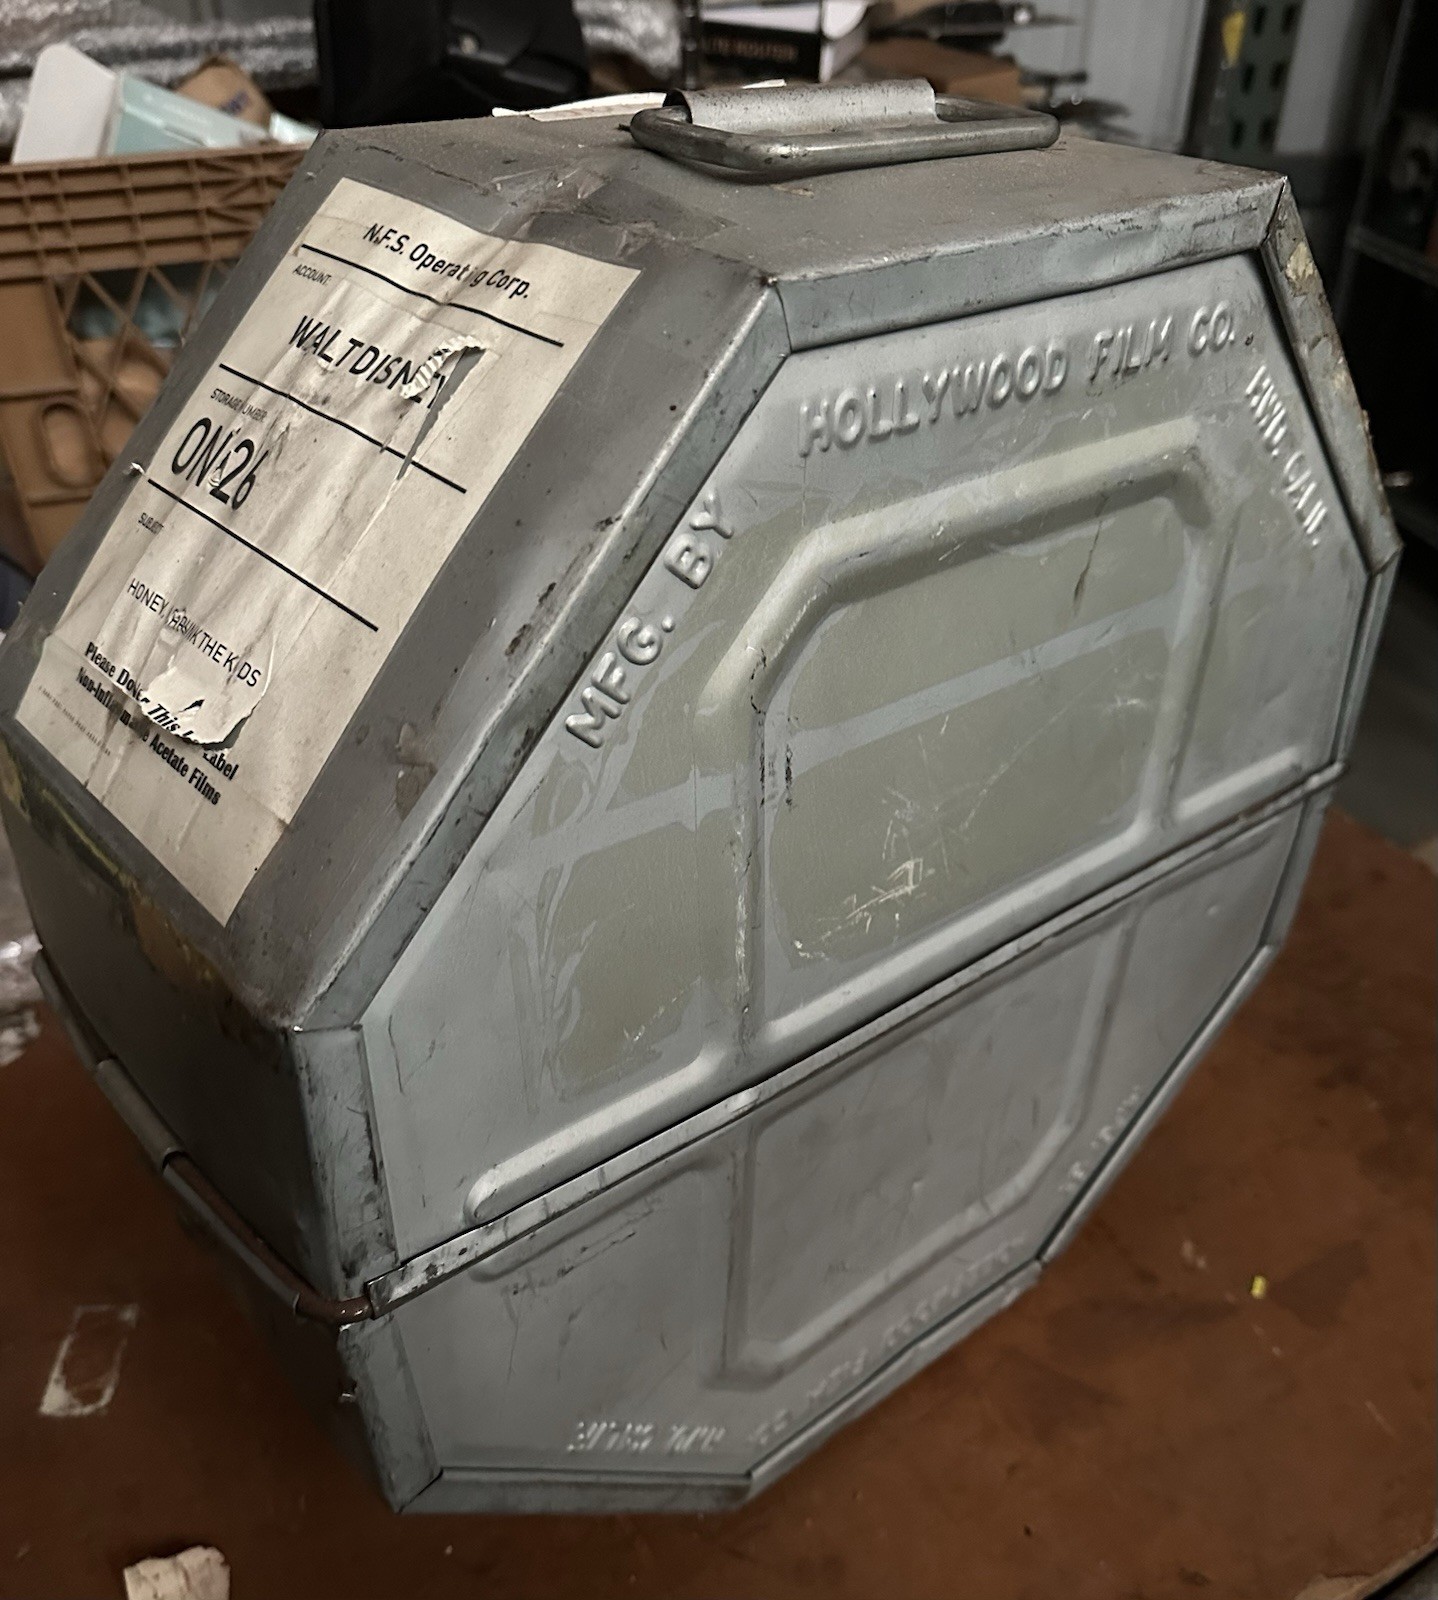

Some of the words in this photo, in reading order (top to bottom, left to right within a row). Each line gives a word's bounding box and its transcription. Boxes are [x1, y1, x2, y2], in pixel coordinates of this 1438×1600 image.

[486, 268, 531, 299] Corp.
[288, 315, 366, 368] WALT
[799, 338, 1069, 458] HOLLYWOOD
[1088, 314, 1174, 384] FILM
[1187, 301, 1237, 358] CO.
[241, 403, 268, 422] UMBER
[198, 631, 228, 663] THE
[565, 613, 676, 749] MFG.
[663, 486, 735, 590] BY
[84, 641, 116, 678] Please
[147, 703, 181, 732] This
[149, 733, 189, 777] Acetate
[188, 767, 222, 806] Films
